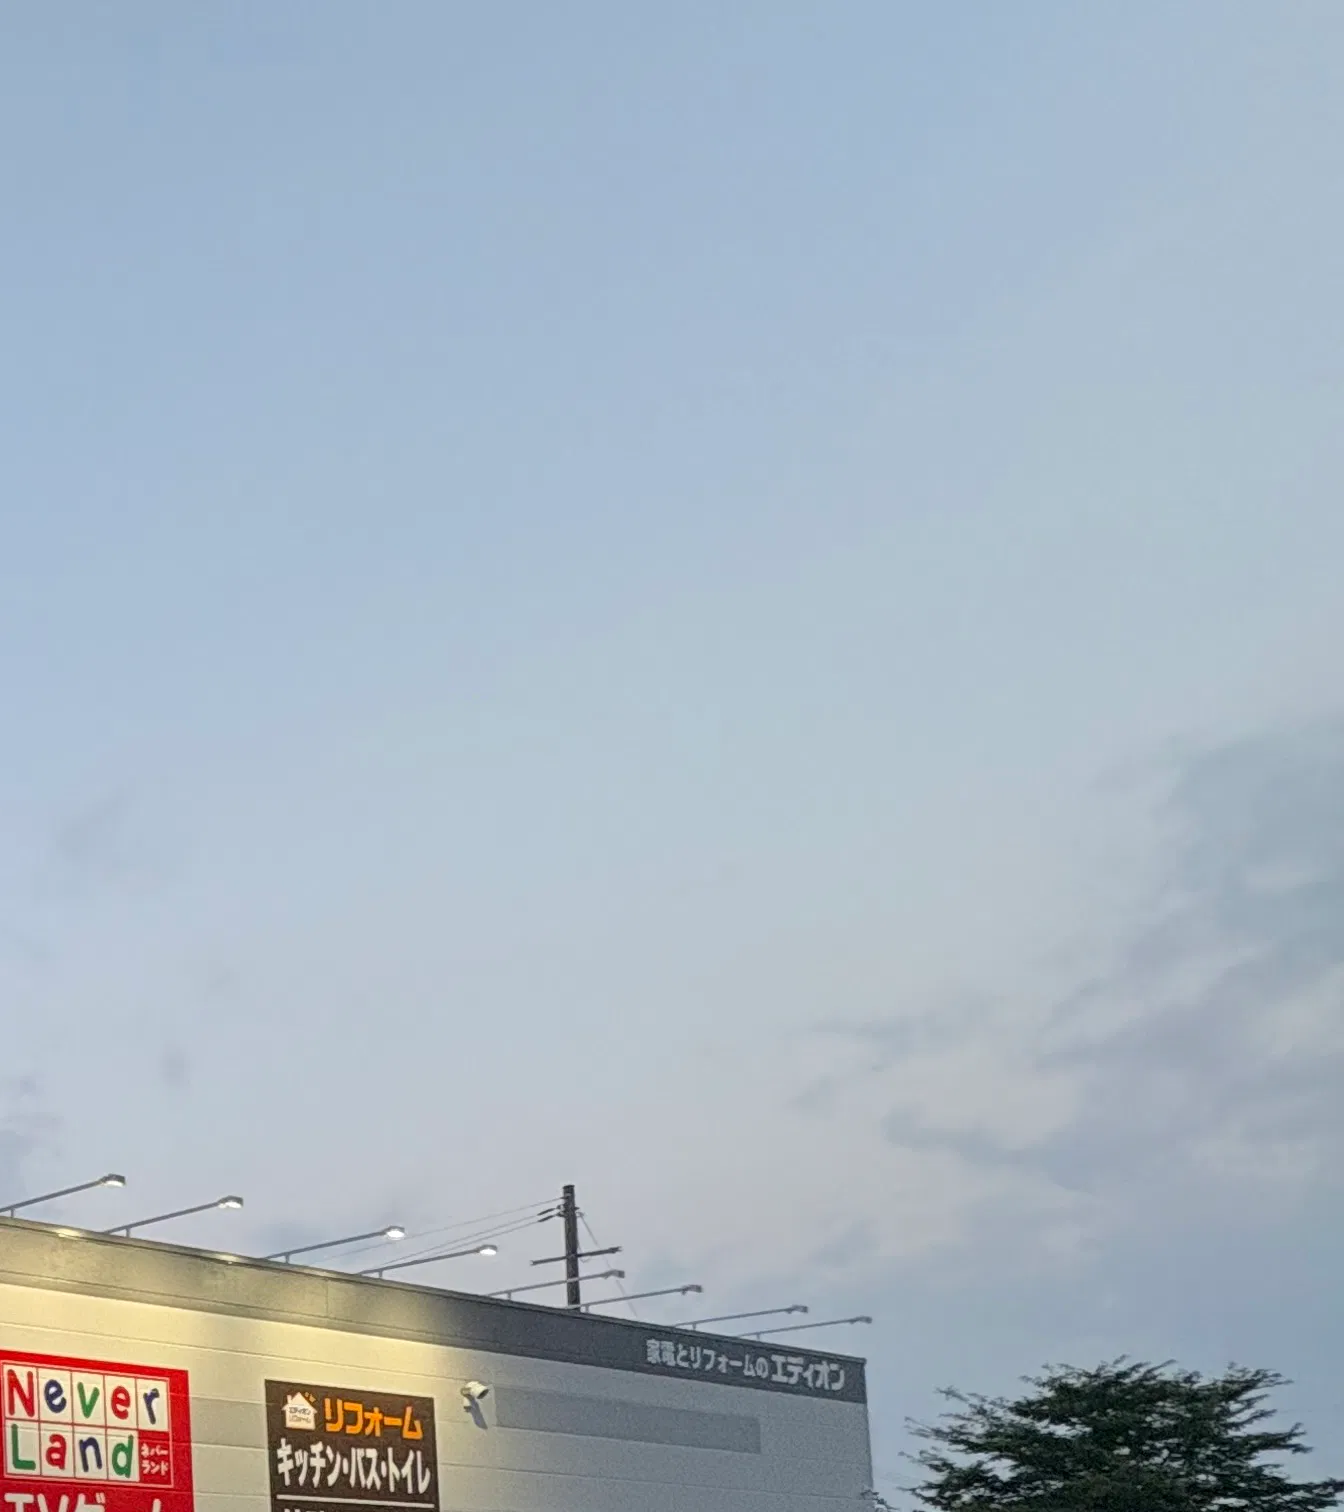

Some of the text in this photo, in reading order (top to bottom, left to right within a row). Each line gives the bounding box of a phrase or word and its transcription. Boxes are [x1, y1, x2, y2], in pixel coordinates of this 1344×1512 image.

[7, 1369, 160, 1425] Never
[324, 1398, 424, 1440] リフォーム
[12, 1424, 134, 1478] Land
[276, 1437, 431, 1494] キッチン・バス・トイレ
